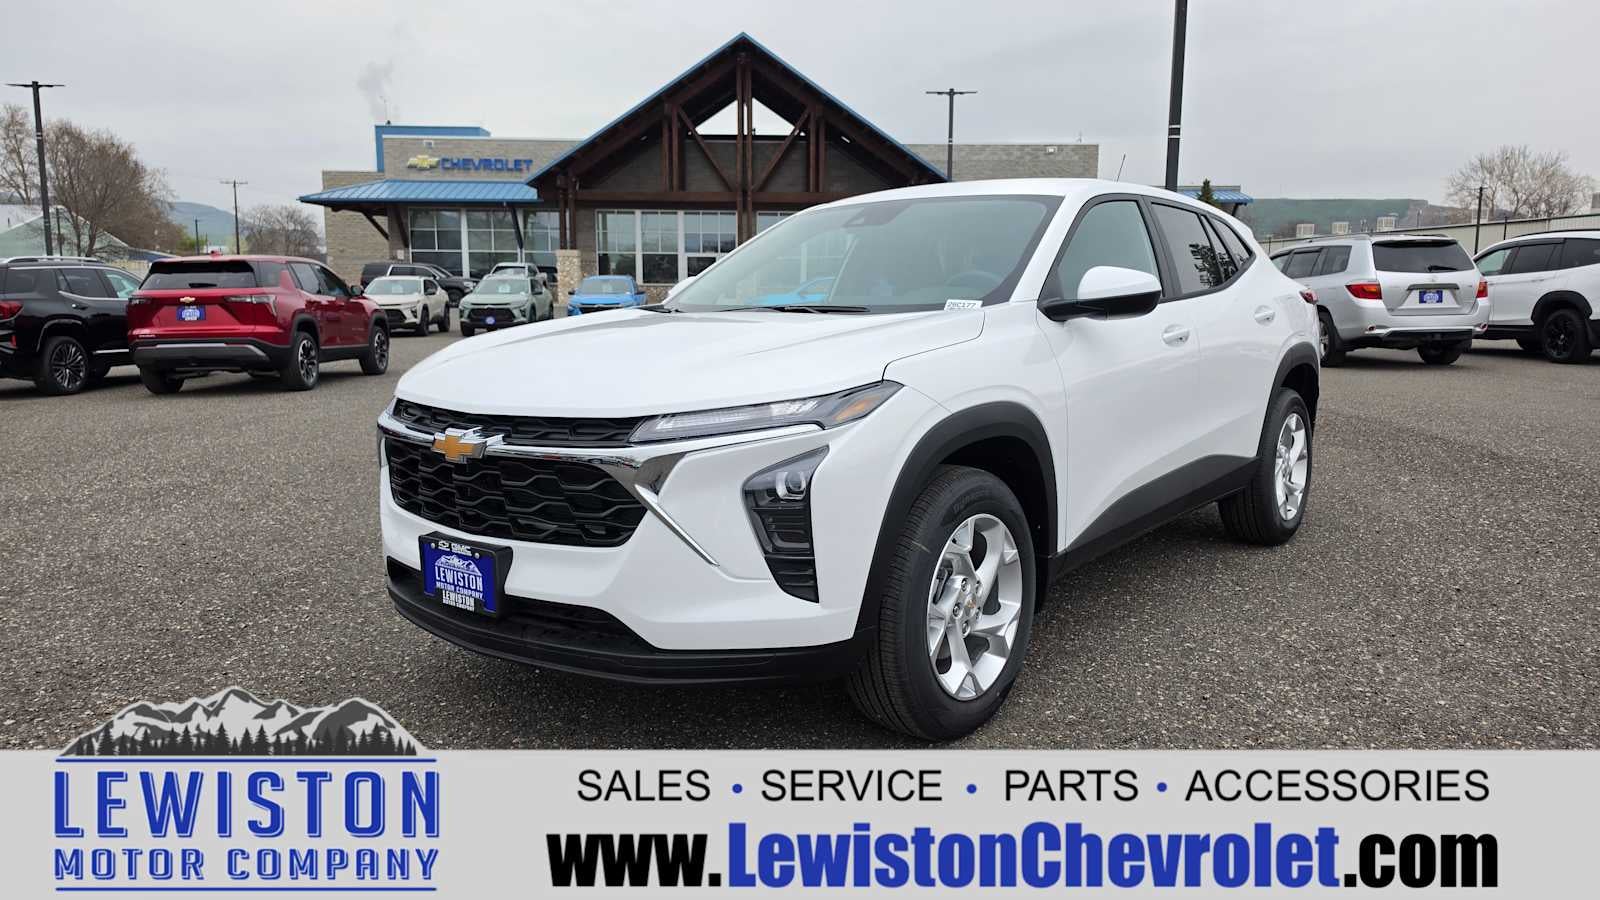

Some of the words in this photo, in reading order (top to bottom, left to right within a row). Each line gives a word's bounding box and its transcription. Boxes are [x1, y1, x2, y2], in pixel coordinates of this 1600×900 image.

[441, 157, 533, 171] CHEVROLET
[434, 566, 483, 592] LEWISTON
[435, 581, 455, 592] MOTOR
[456, 586, 484, 600] COMPANY
[442, 590, 475, 607] LEWISTON
